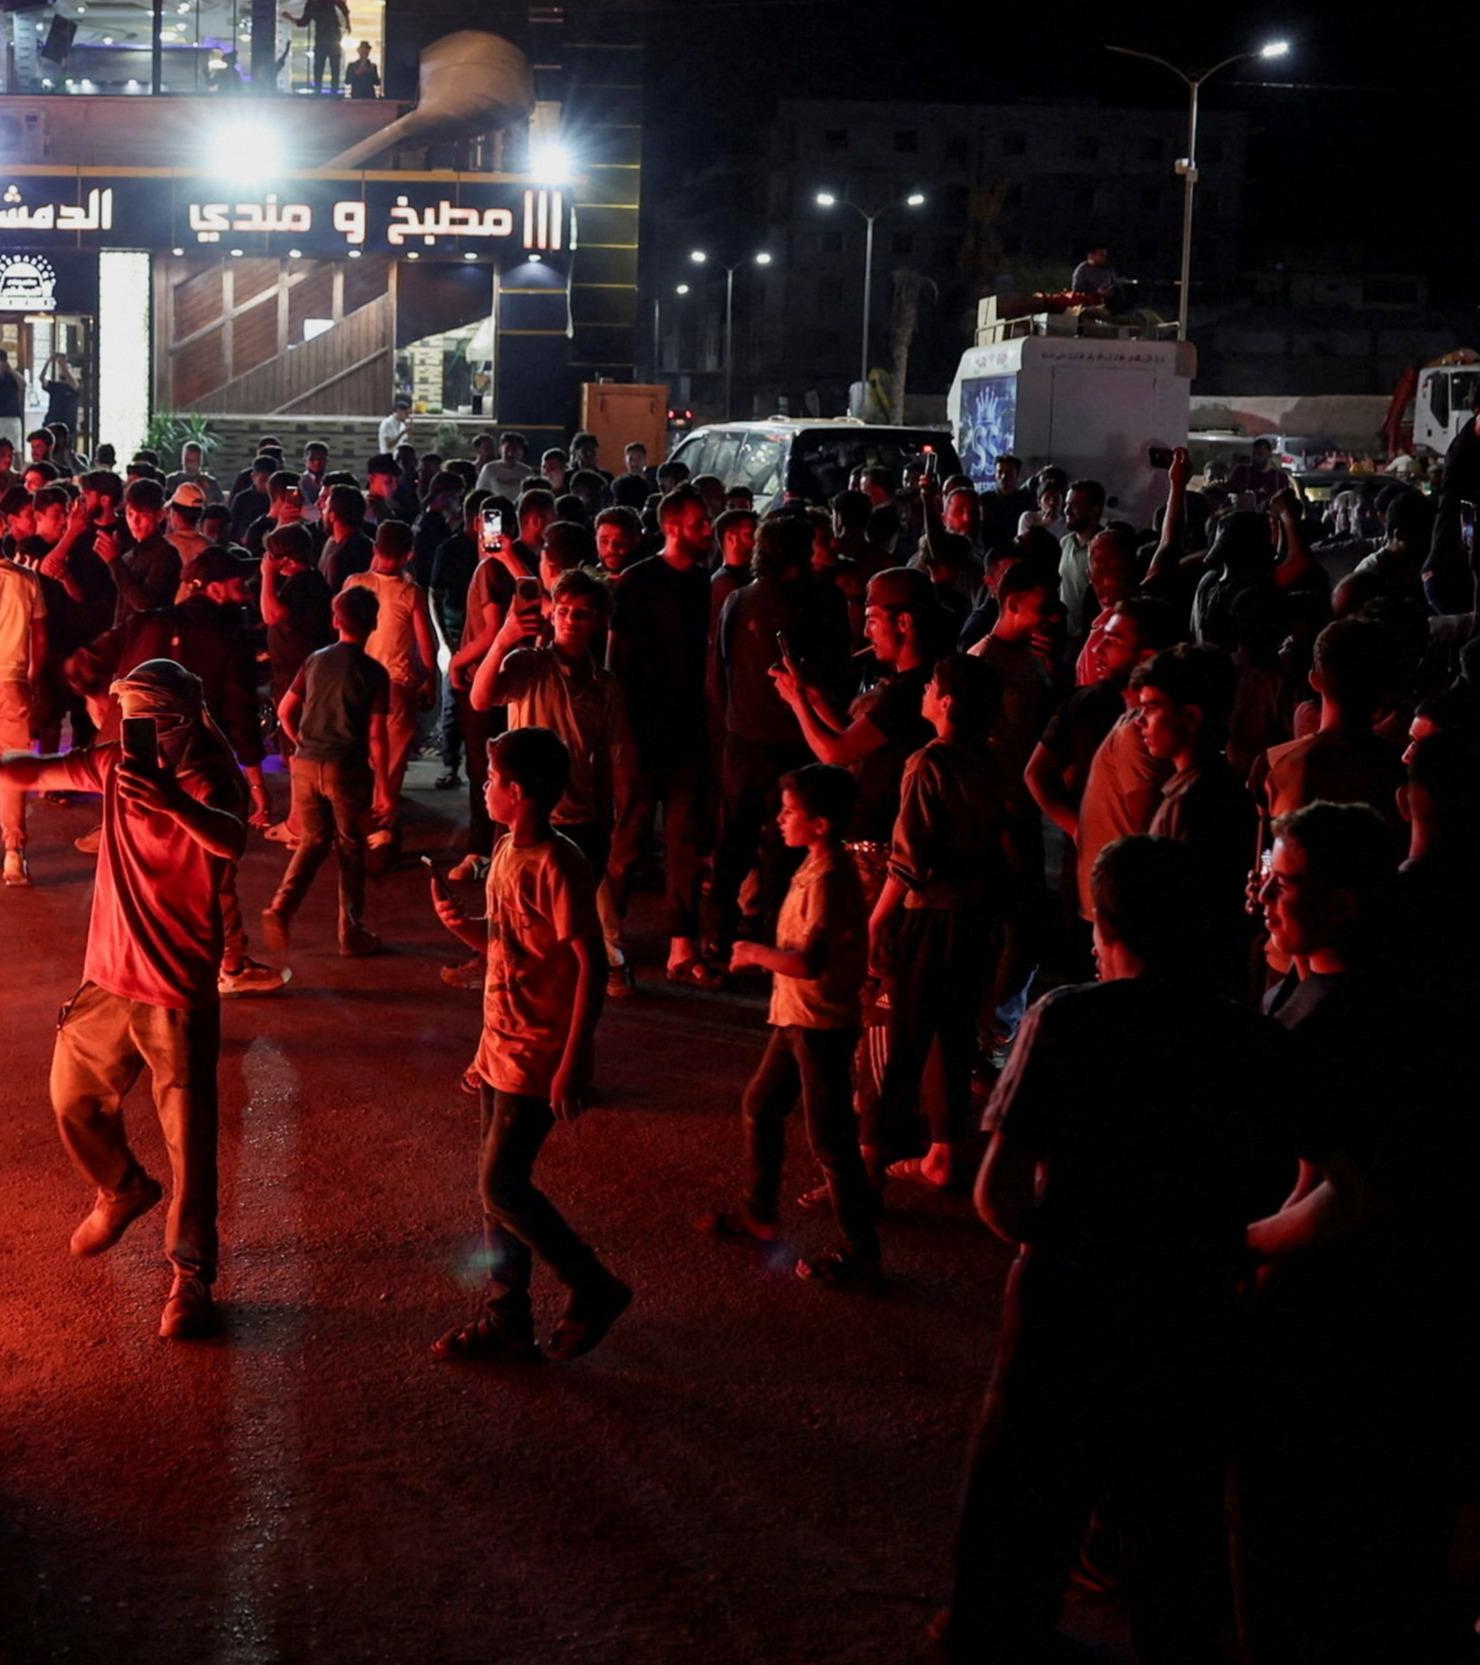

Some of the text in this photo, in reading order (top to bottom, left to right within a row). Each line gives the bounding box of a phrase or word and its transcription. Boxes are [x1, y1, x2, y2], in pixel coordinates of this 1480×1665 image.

[189, 193, 311, 243] مندي
[333, 201, 366, 244] و
[387, 195, 513, 246] مطبخ
